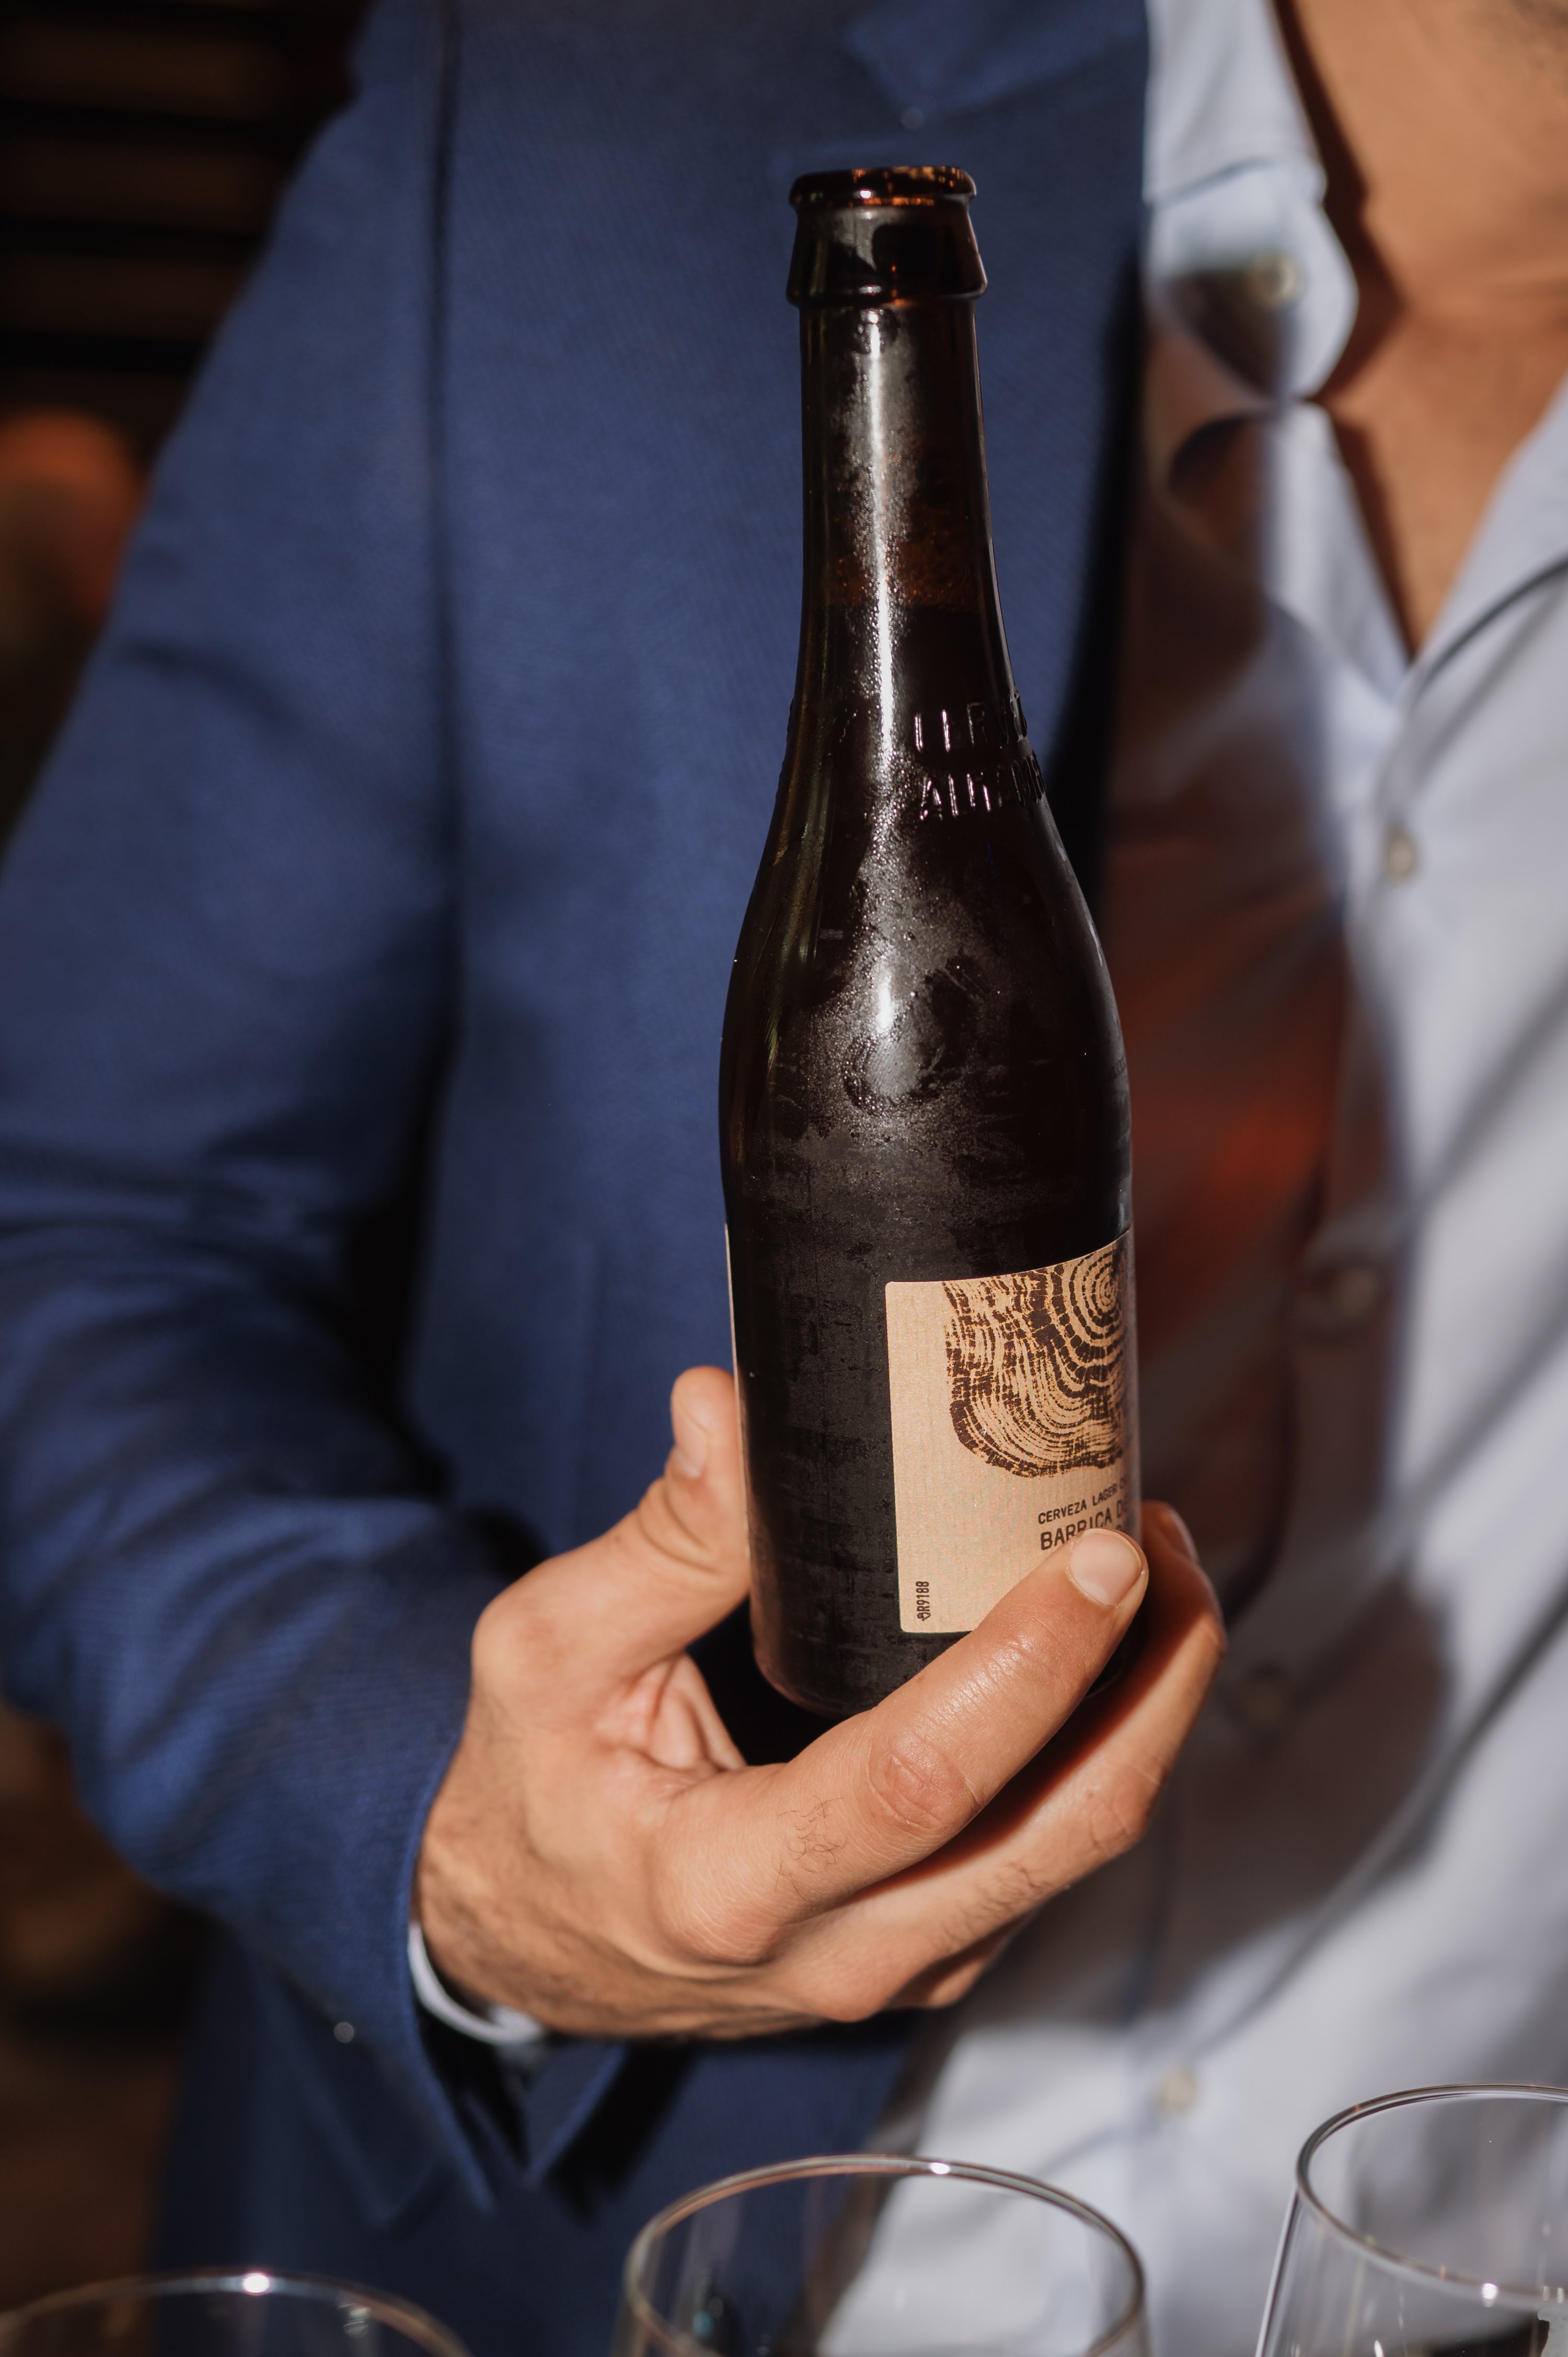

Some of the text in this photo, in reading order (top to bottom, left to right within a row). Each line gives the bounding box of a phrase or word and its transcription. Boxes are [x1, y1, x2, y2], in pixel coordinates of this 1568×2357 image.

[1037, 1484, 1117, 1525] CERVEZA LAGER
[1040, 1507, 1112, 1551] BARRICA
